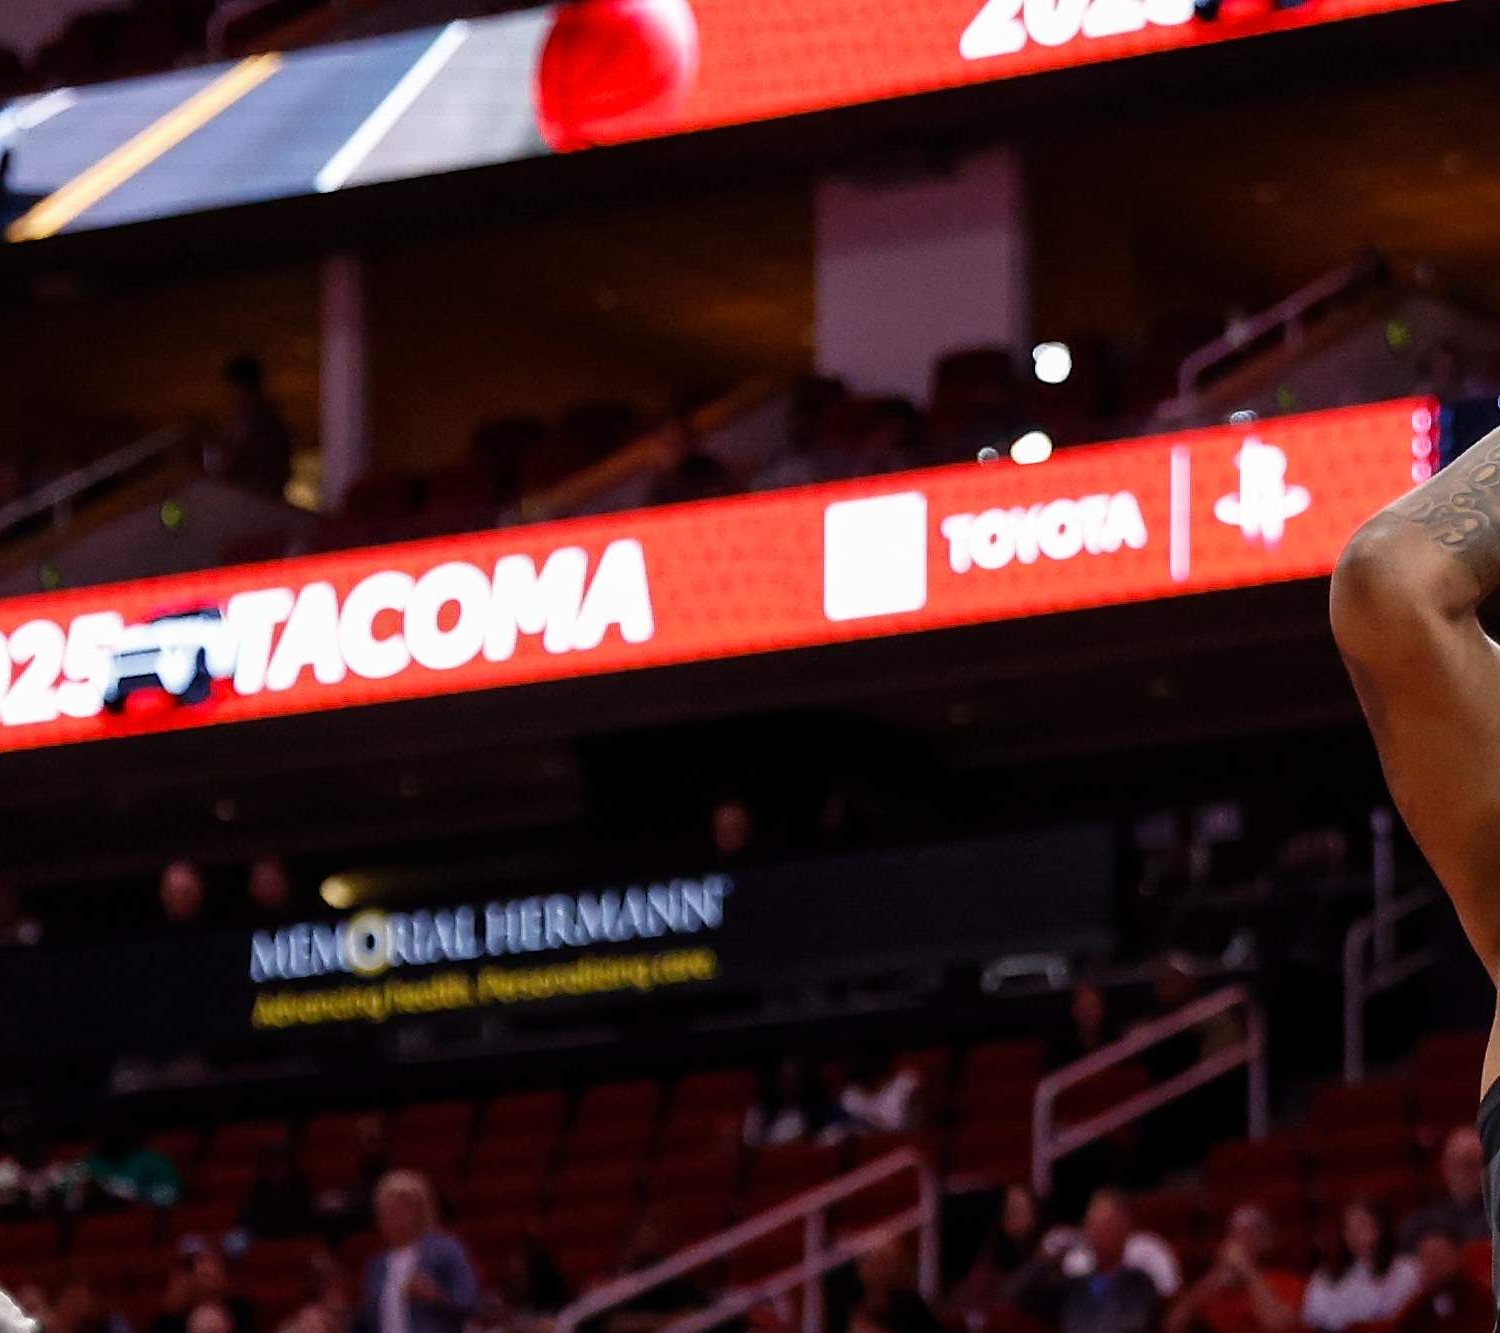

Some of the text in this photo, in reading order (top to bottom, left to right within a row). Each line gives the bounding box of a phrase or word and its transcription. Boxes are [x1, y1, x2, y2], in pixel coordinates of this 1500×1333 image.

[942, 490, 1148, 574] TOYOTA
[228, 537, 655, 696] TACOMA
[250, 902, 476, 983] MEMORIAL
